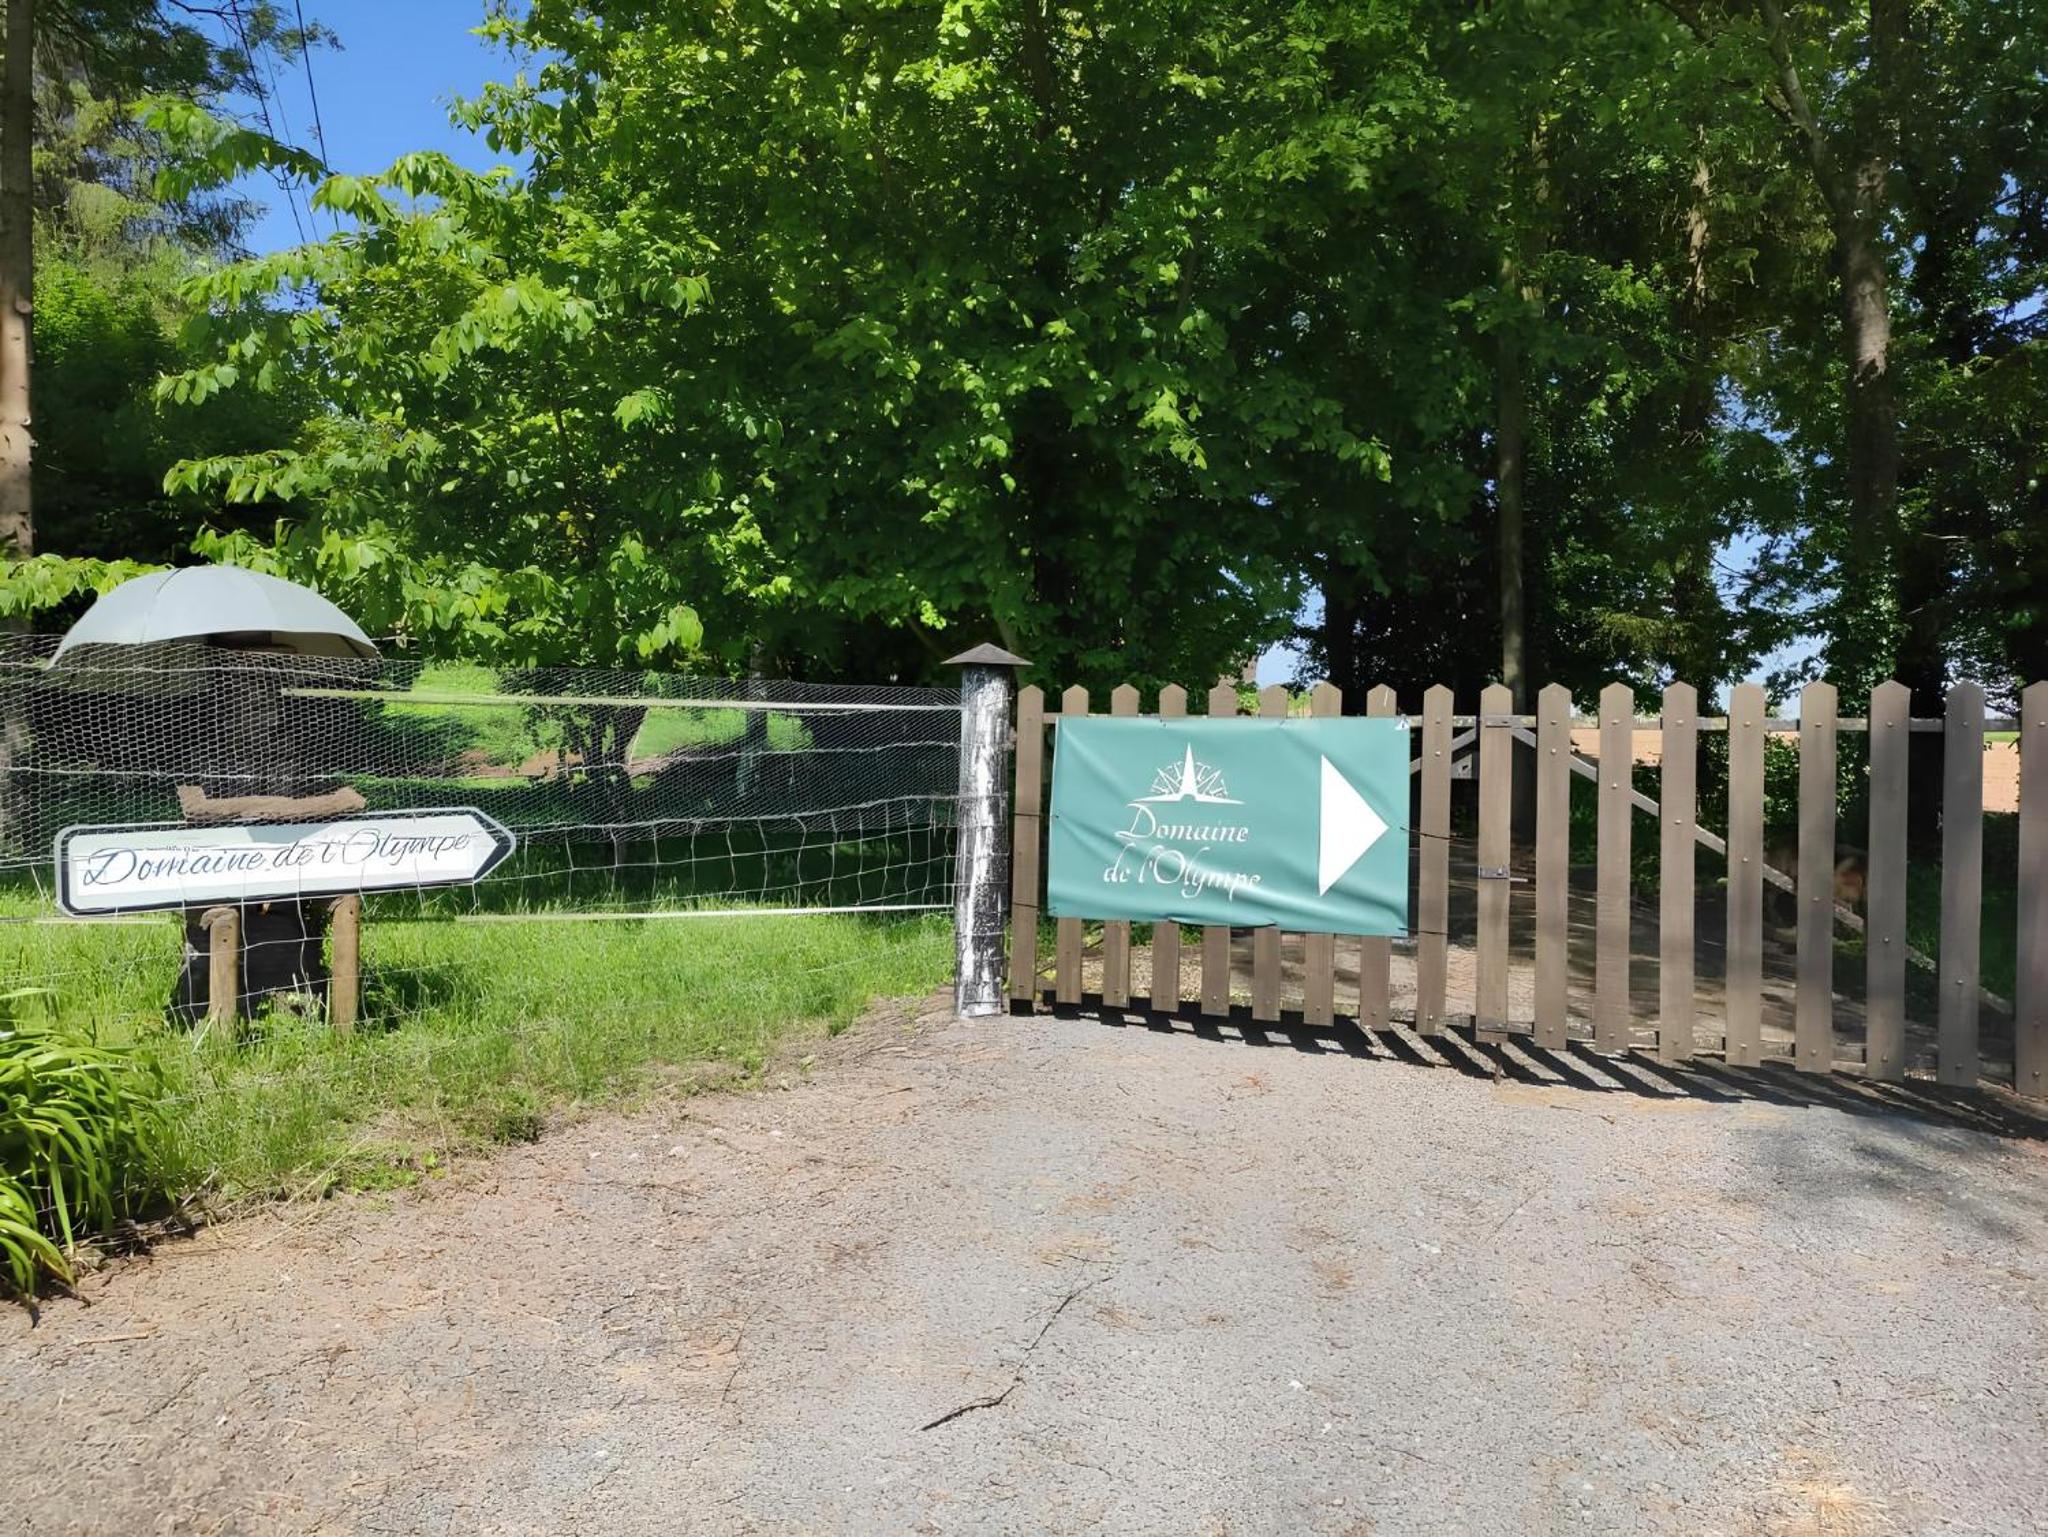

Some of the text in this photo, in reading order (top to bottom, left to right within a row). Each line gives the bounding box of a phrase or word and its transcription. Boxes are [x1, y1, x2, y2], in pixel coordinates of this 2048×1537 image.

[1115, 803, 1249, 842] Domaine
[82, 827, 470, 886] Domaine de l'Olympe
[1103, 843, 1261, 901] de l'Olympe
